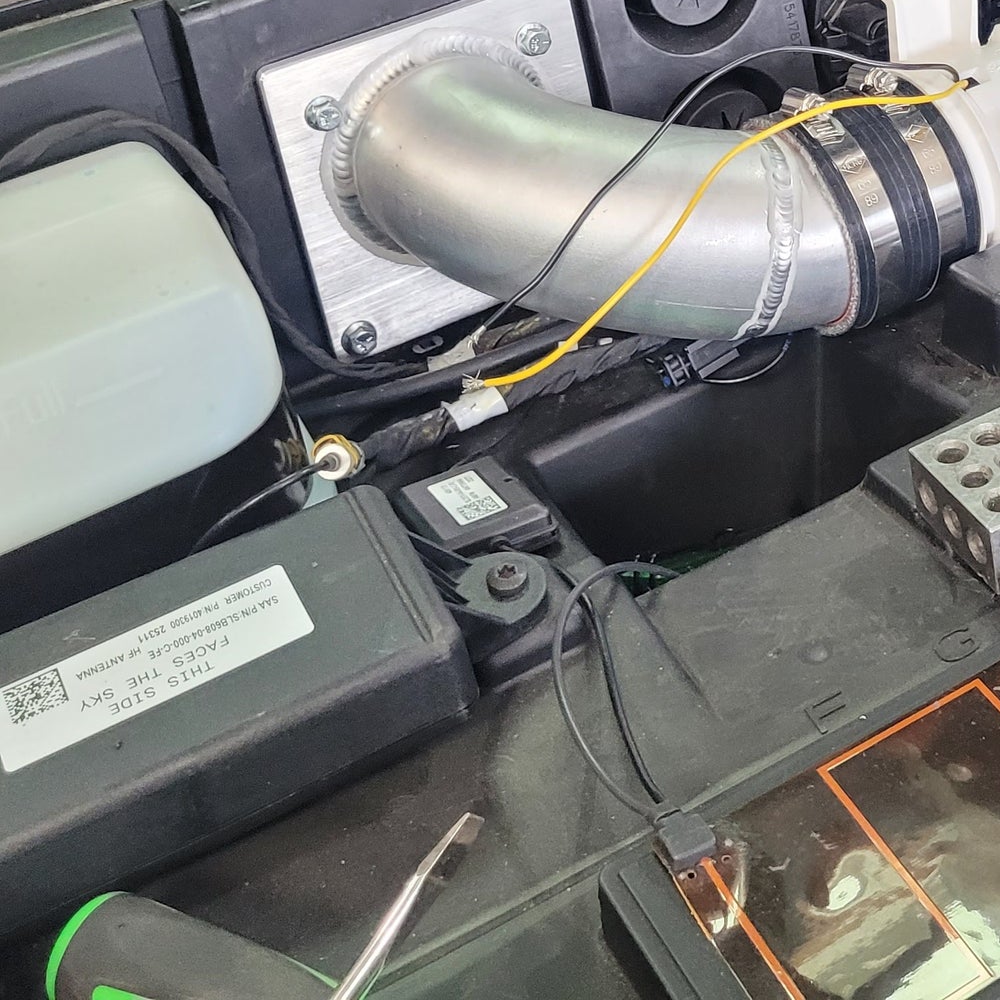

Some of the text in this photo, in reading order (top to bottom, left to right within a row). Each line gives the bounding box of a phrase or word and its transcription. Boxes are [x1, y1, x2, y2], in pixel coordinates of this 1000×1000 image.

[224, 578, 272, 605] CUSTOMER
[257, 594, 279, 610] SAA
[137, 625, 166, 644] 25311
[75, 646, 142, 682] HF ANTENNA
[80, 635, 230, 712] FACES THE SKY
[110, 662, 215, 715] THIS SIDE
